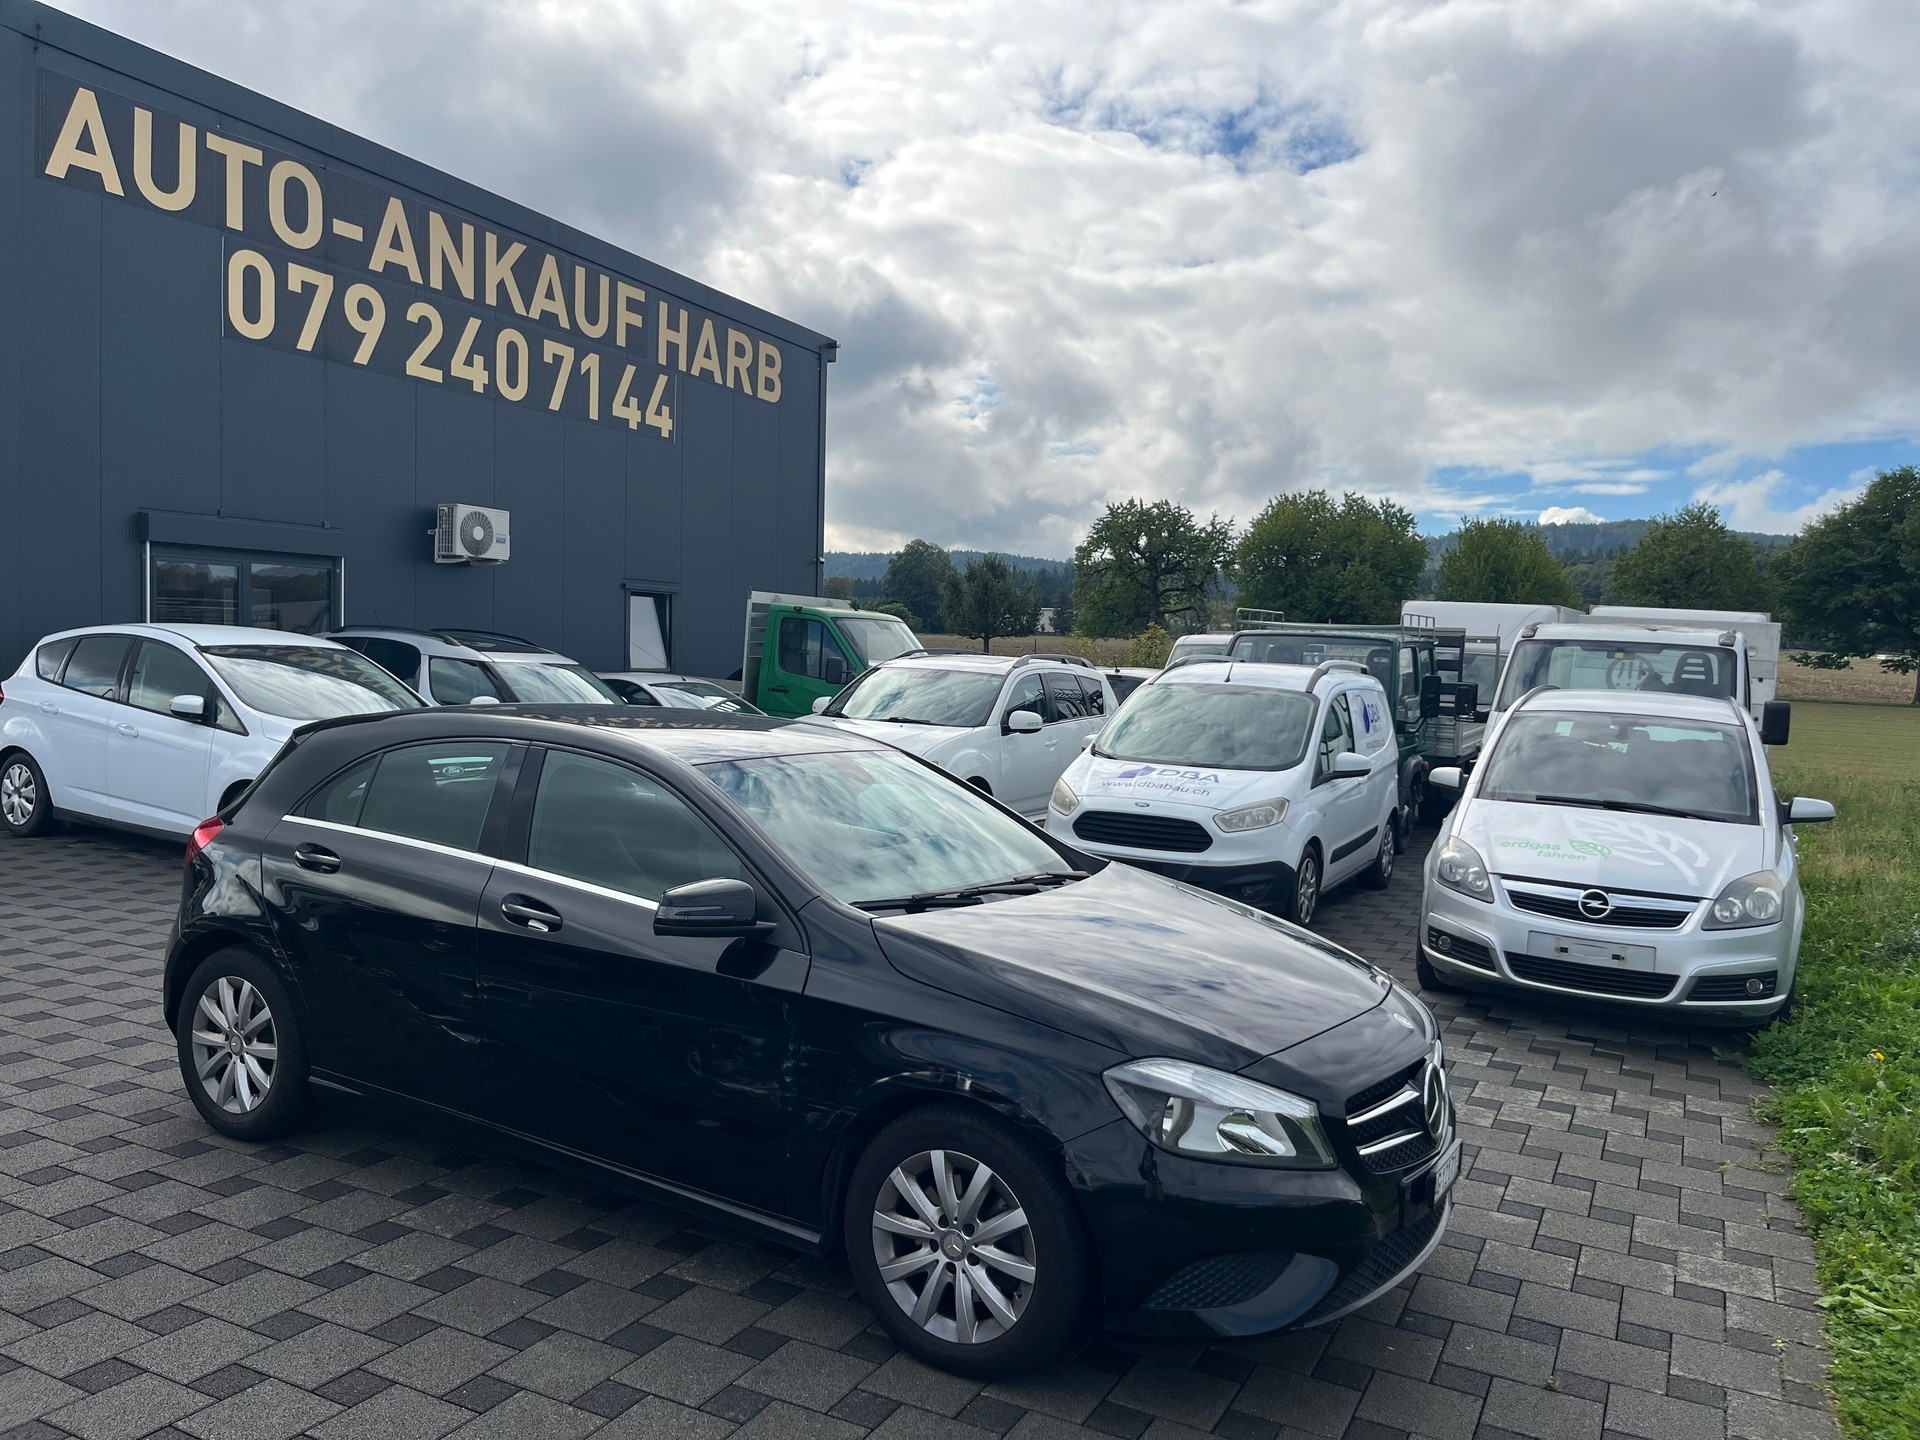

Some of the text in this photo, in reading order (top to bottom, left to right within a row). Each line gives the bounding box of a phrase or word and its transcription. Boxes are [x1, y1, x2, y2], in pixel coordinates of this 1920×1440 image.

[44, 86, 783, 404] AUTO-ANKAUF HARB
[227, 248, 386, 366] 079
[405, 301, 530, 402] 240
[1156, 769, 1219, 784] DBA
[1102, 780, 1210, 796] www.dbabau.ch
[1500, 841, 1561, 851] erdgas
[1537, 851, 1586, 861] fahren
